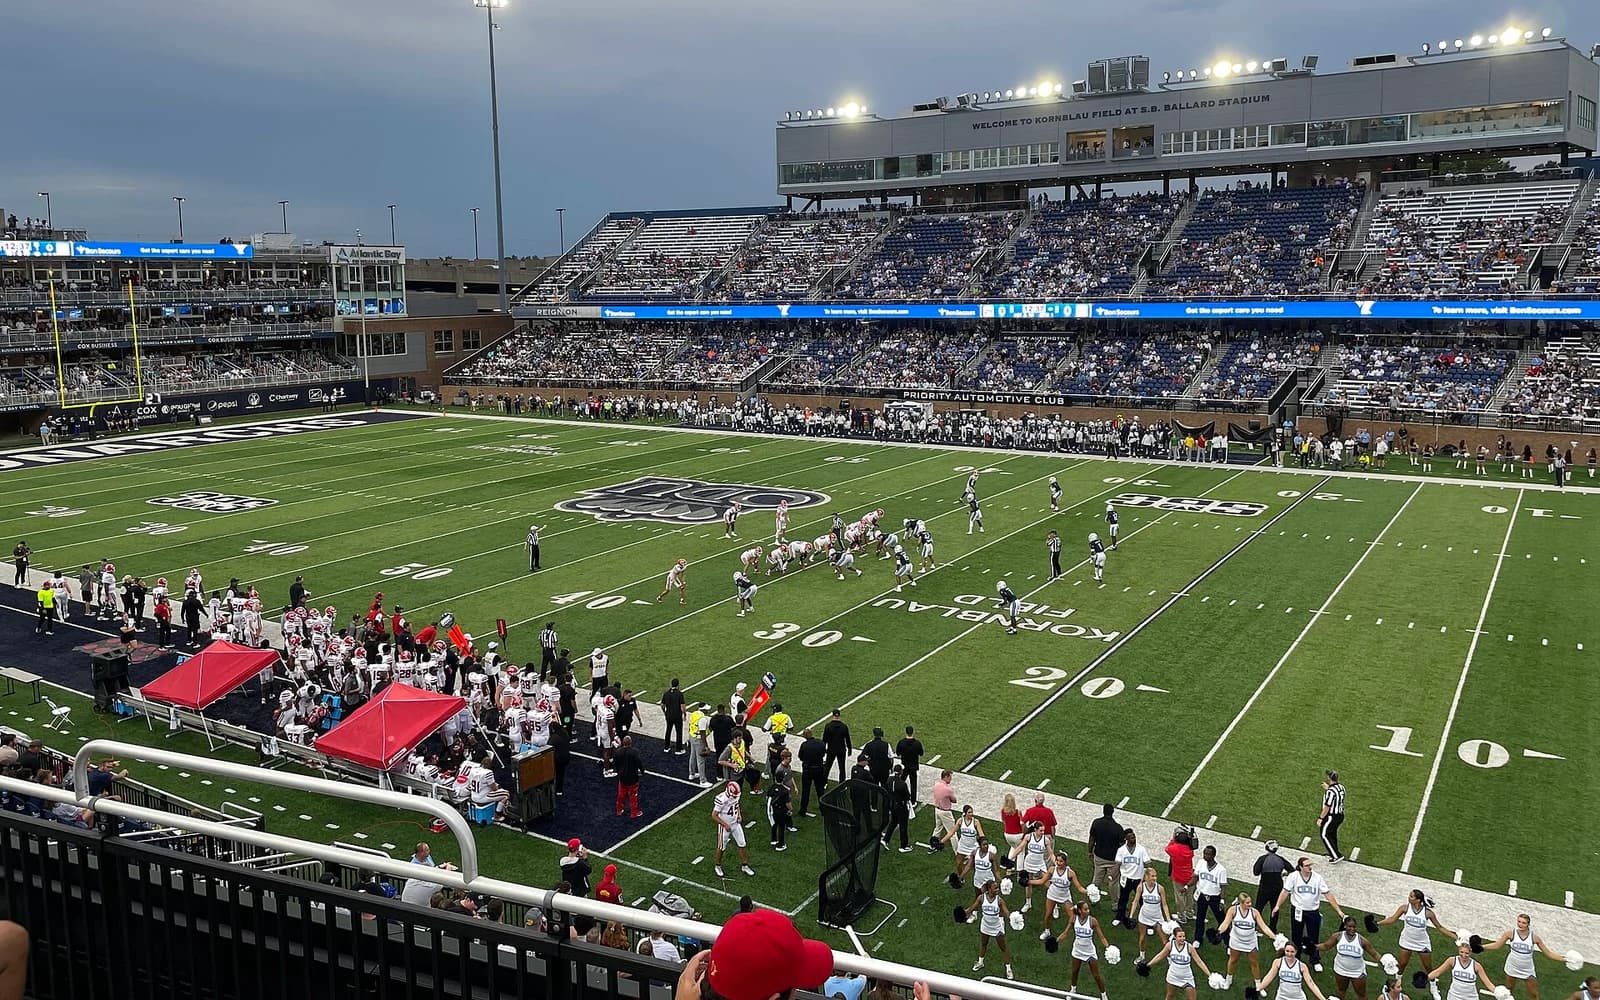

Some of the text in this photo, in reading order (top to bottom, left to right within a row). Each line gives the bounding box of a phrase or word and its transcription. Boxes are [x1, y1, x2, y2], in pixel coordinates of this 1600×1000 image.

[972, 120, 1018, 130] WELCOME
[1035, 112, 1089, 124] KORNBLAU
[1092, 107, 1122, 118] FIELD
[1124, 107, 1138, 115] AT
[1164, 100, 1215, 111] BALLARD
[1218, 94, 1270, 107] STADIUM
[350, 250, 401, 259] Atlantic Bay
[1432, 306, 1442, 314] To
[1443, 306, 1465, 314] learn
[1465, 307, 1489, 315] more,
[1490, 306, 1508, 314] visit
[216, 400, 238, 409] pepsi
[903, 391, 1065, 405] PRIORITY AUTOMOTIVE CLUB
[136, 407, 158, 415] COX
[379, 562, 453, 580] 50
[549, 590, 627, 610] 40
[232, 603, 244, 612] 20
[753, 622, 843, 648] 30
[399, 670, 411, 678] 28
[1008, 666, 1125, 699] 20
[1369, 724, 1510, 768] 10
